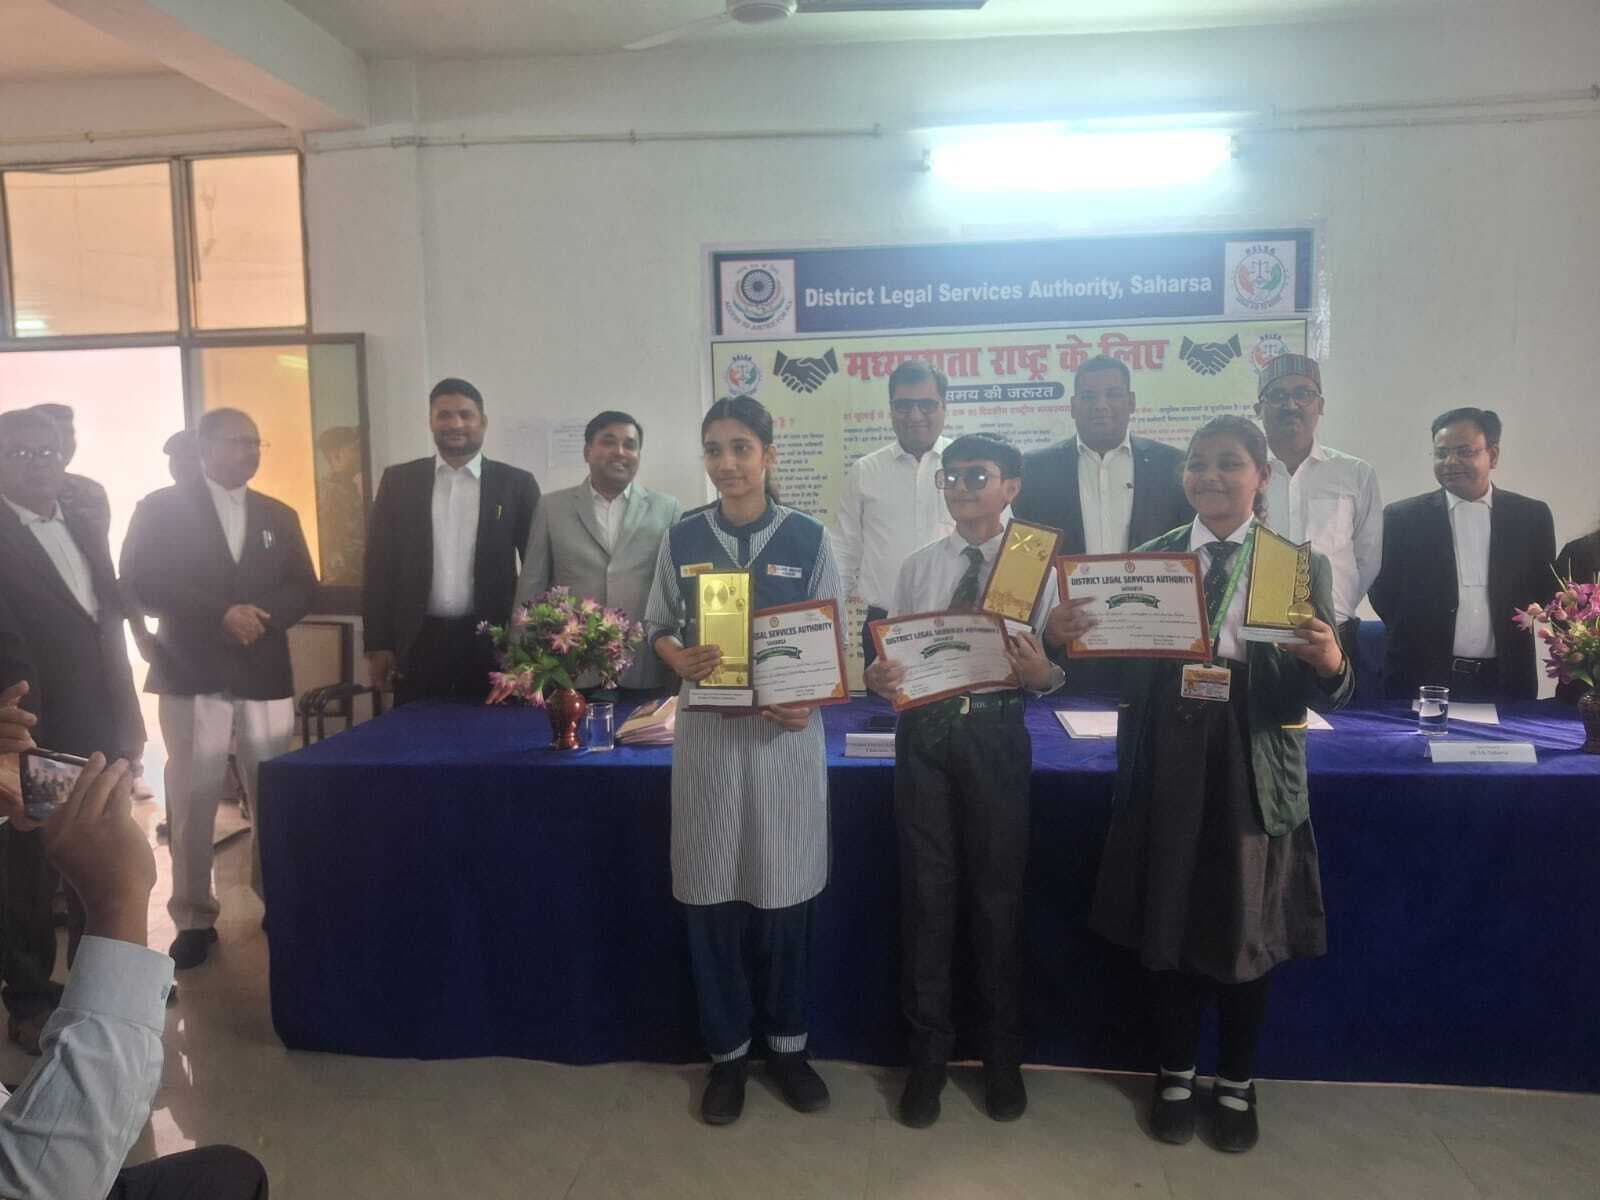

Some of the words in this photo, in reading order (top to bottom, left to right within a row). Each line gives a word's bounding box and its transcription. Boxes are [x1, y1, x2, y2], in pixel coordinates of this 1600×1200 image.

[804, 286, 875, 307] District
[880, 284, 933, 308] Legal
[938, 281, 1023, 302] Services
[1028, 276, 1124, 300] Authority,
[1130, 273, 1213, 294] Saharsa
[987, 343, 1050, 381] राष्ट्र
[1055, 334, 1092, 372] के
[983, 384, 1002, 400] की
[1071, 577, 1100, 585] DISTRICT
[1102, 576, 1122, 584] LEGAL
[1123, 575, 1154, 584] SERVICES
[1156, 575, 1193, 584] AUTHORITY
[768, 625, 797, 638] SERVICES
[798, 622, 832, 634] AUTHORITY
[886, 632, 913, 645] DISTRICT
[914, 629, 933, 640] LEGAL
